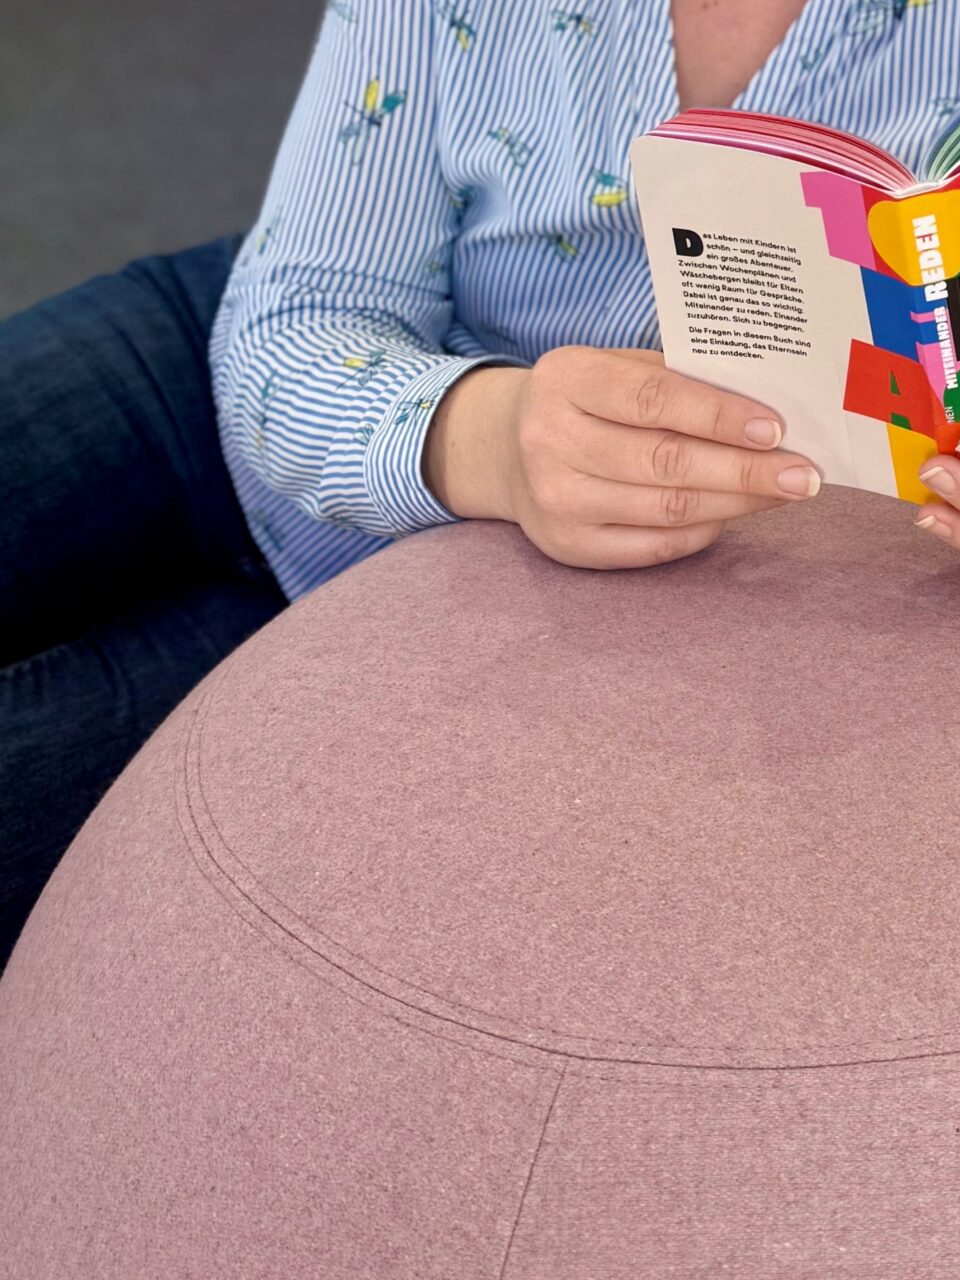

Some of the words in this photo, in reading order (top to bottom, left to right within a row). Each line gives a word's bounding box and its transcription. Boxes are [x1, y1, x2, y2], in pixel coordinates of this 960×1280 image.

[706, 243, 731, 252] schön
[740, 247, 756, 256] und
[757, 250, 802, 266] gleichzeitig
[713, 233, 738, 243] Leben
[740, 237, 753, 245] mit
[755, 239, 786, 251] Kindern
[787, 245, 797, 254] ist
[706, 253, 719, 261] ein
[721, 255, 748, 265] großes
[750, 258, 794, 272] Abenteuer.
[911, 214, 949, 302] REDEN
[678, 259, 718, 270] Zwischen
[719, 264, 780, 280] Wochenplänen
[781, 274, 797, 283] und
[679, 270, 741, 283] Wäschebergen
[742, 277, 766, 288] bleibt
[766, 280, 778, 289] für
[780, 283, 804, 294] Eltern
[683, 290, 706, 299] Dabei
[707, 293, 718, 301] ist
[719, 296, 744, 304] genau
[746, 298, 760, 306] das
[695, 282, 721, 292] wenig
[722, 284, 745, 294] Raum
[746, 288, 758, 296] für
[760, 290, 805, 304] Gespräche.
[685, 301, 734, 312] Miteinander
[747, 308, 773, 318] reden.
[774, 311, 808, 324] Einander
[687, 312, 731, 322] zuzuhören.
[732, 316, 751, 324] Sich
[763, 320, 805, 333] begegnen.
[688, 326, 702, 334] Die
[704, 328, 732, 337] Fragen
[743, 332, 772, 341] diesem
[773, 335, 793, 344] Buch
[795, 339, 812, 348] sind
[709, 338, 751, 349] Einladung,
[752, 342, 767, 350] das
[768, 344, 808, 356] Elternsein
[933, 306, 959, 390] MITEINANDER
[720, 350, 765, 360] entdecken.
